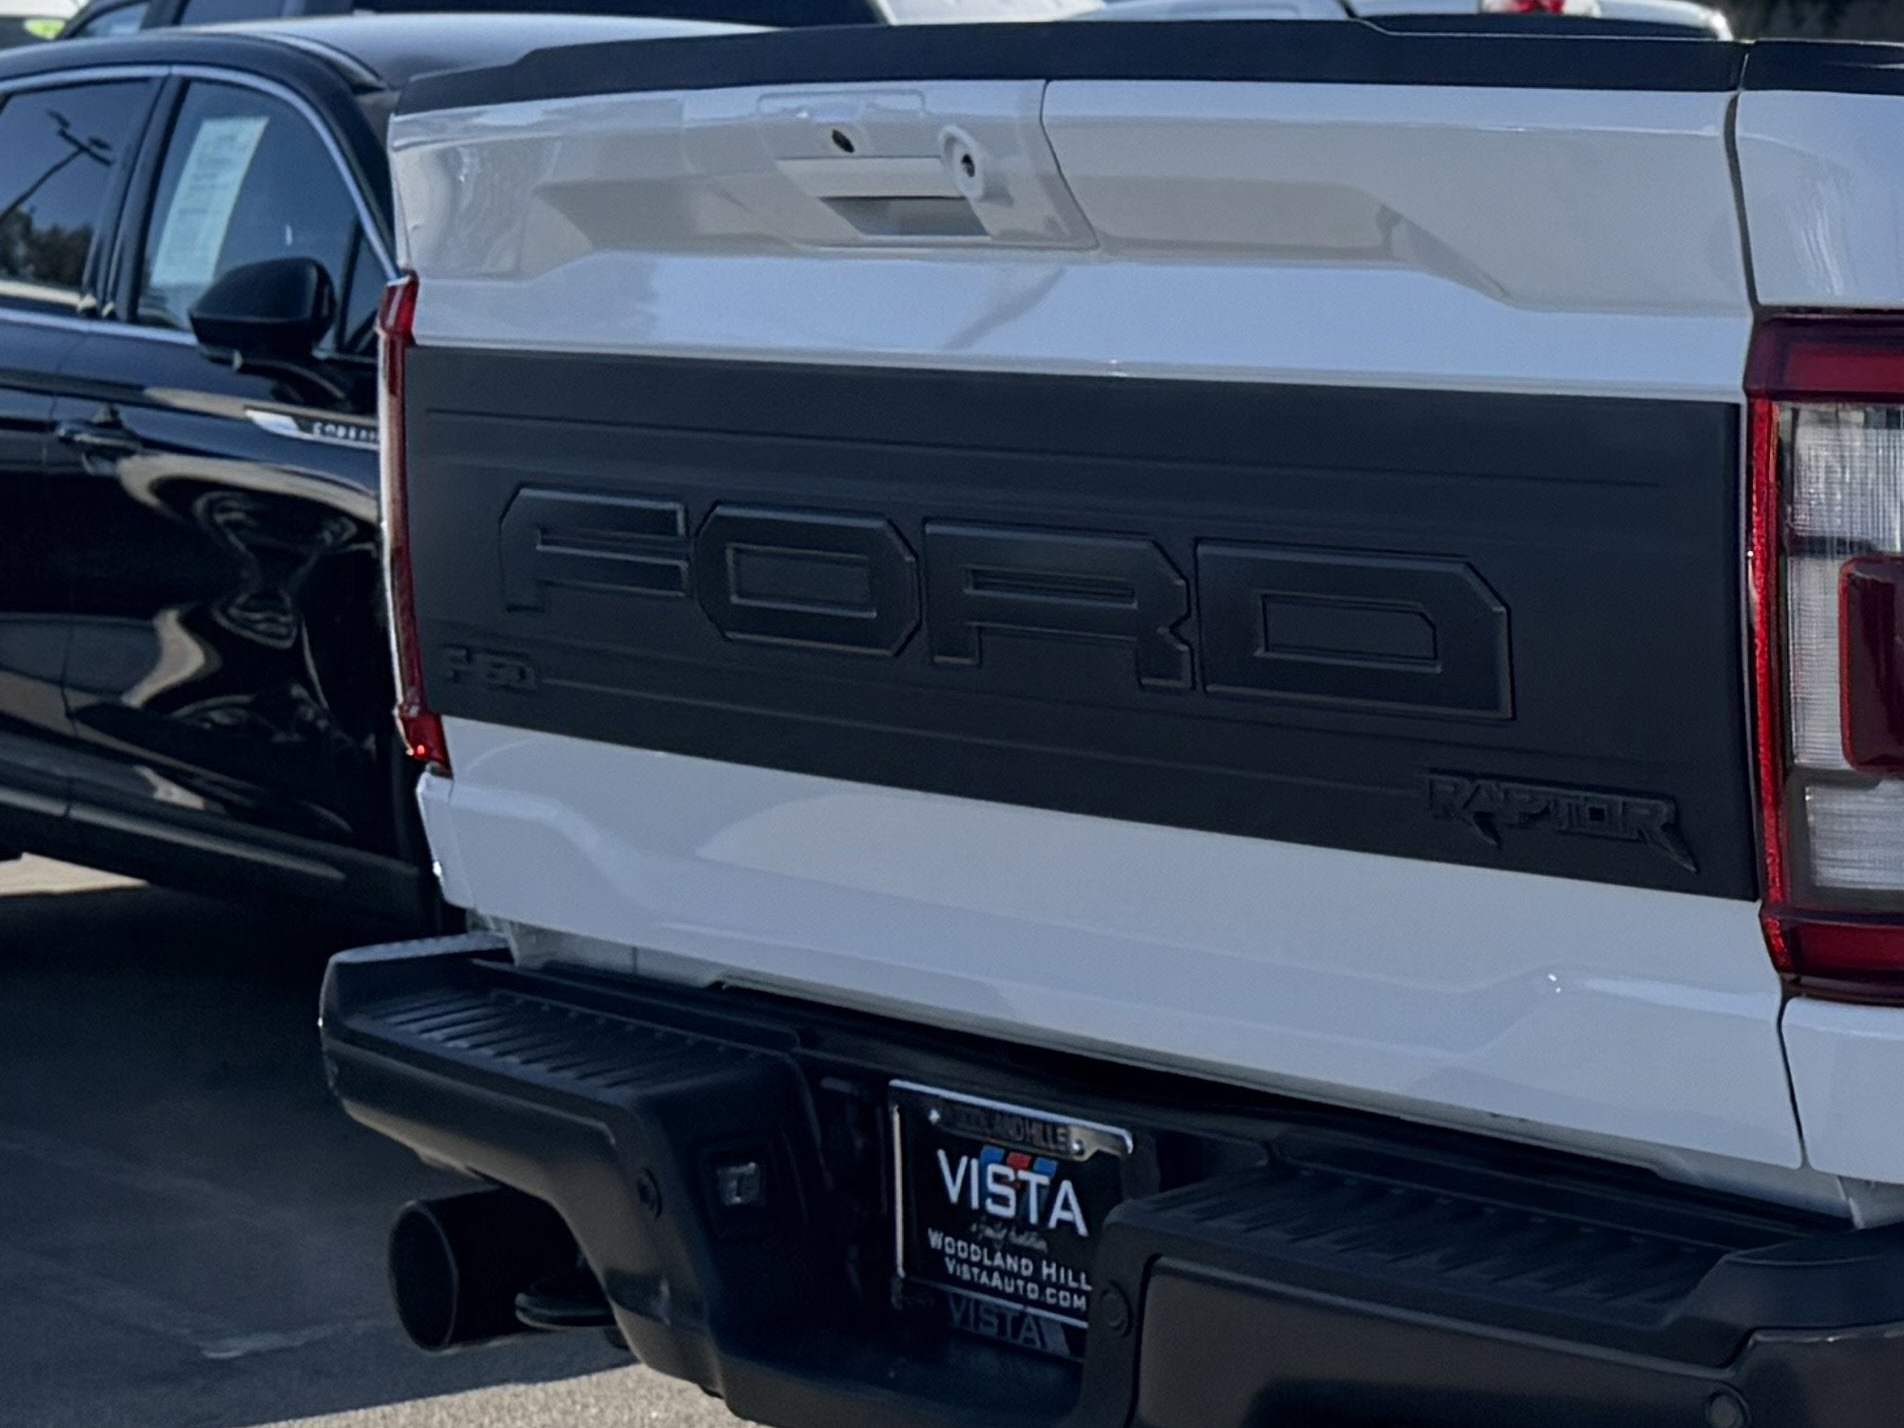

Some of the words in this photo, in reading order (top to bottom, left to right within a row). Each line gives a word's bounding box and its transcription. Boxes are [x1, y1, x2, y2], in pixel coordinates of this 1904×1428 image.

[497, 484, 1517, 722] FORD
[1421, 769, 1698, 874] RAPTOR
[936, 1148, 1089, 1237] VISTA
[927, 1227, 1034, 1277] WOODLAND
[1041, 1259, 1093, 1292] HILL
[949, 1293, 1042, 1349] VISTA
